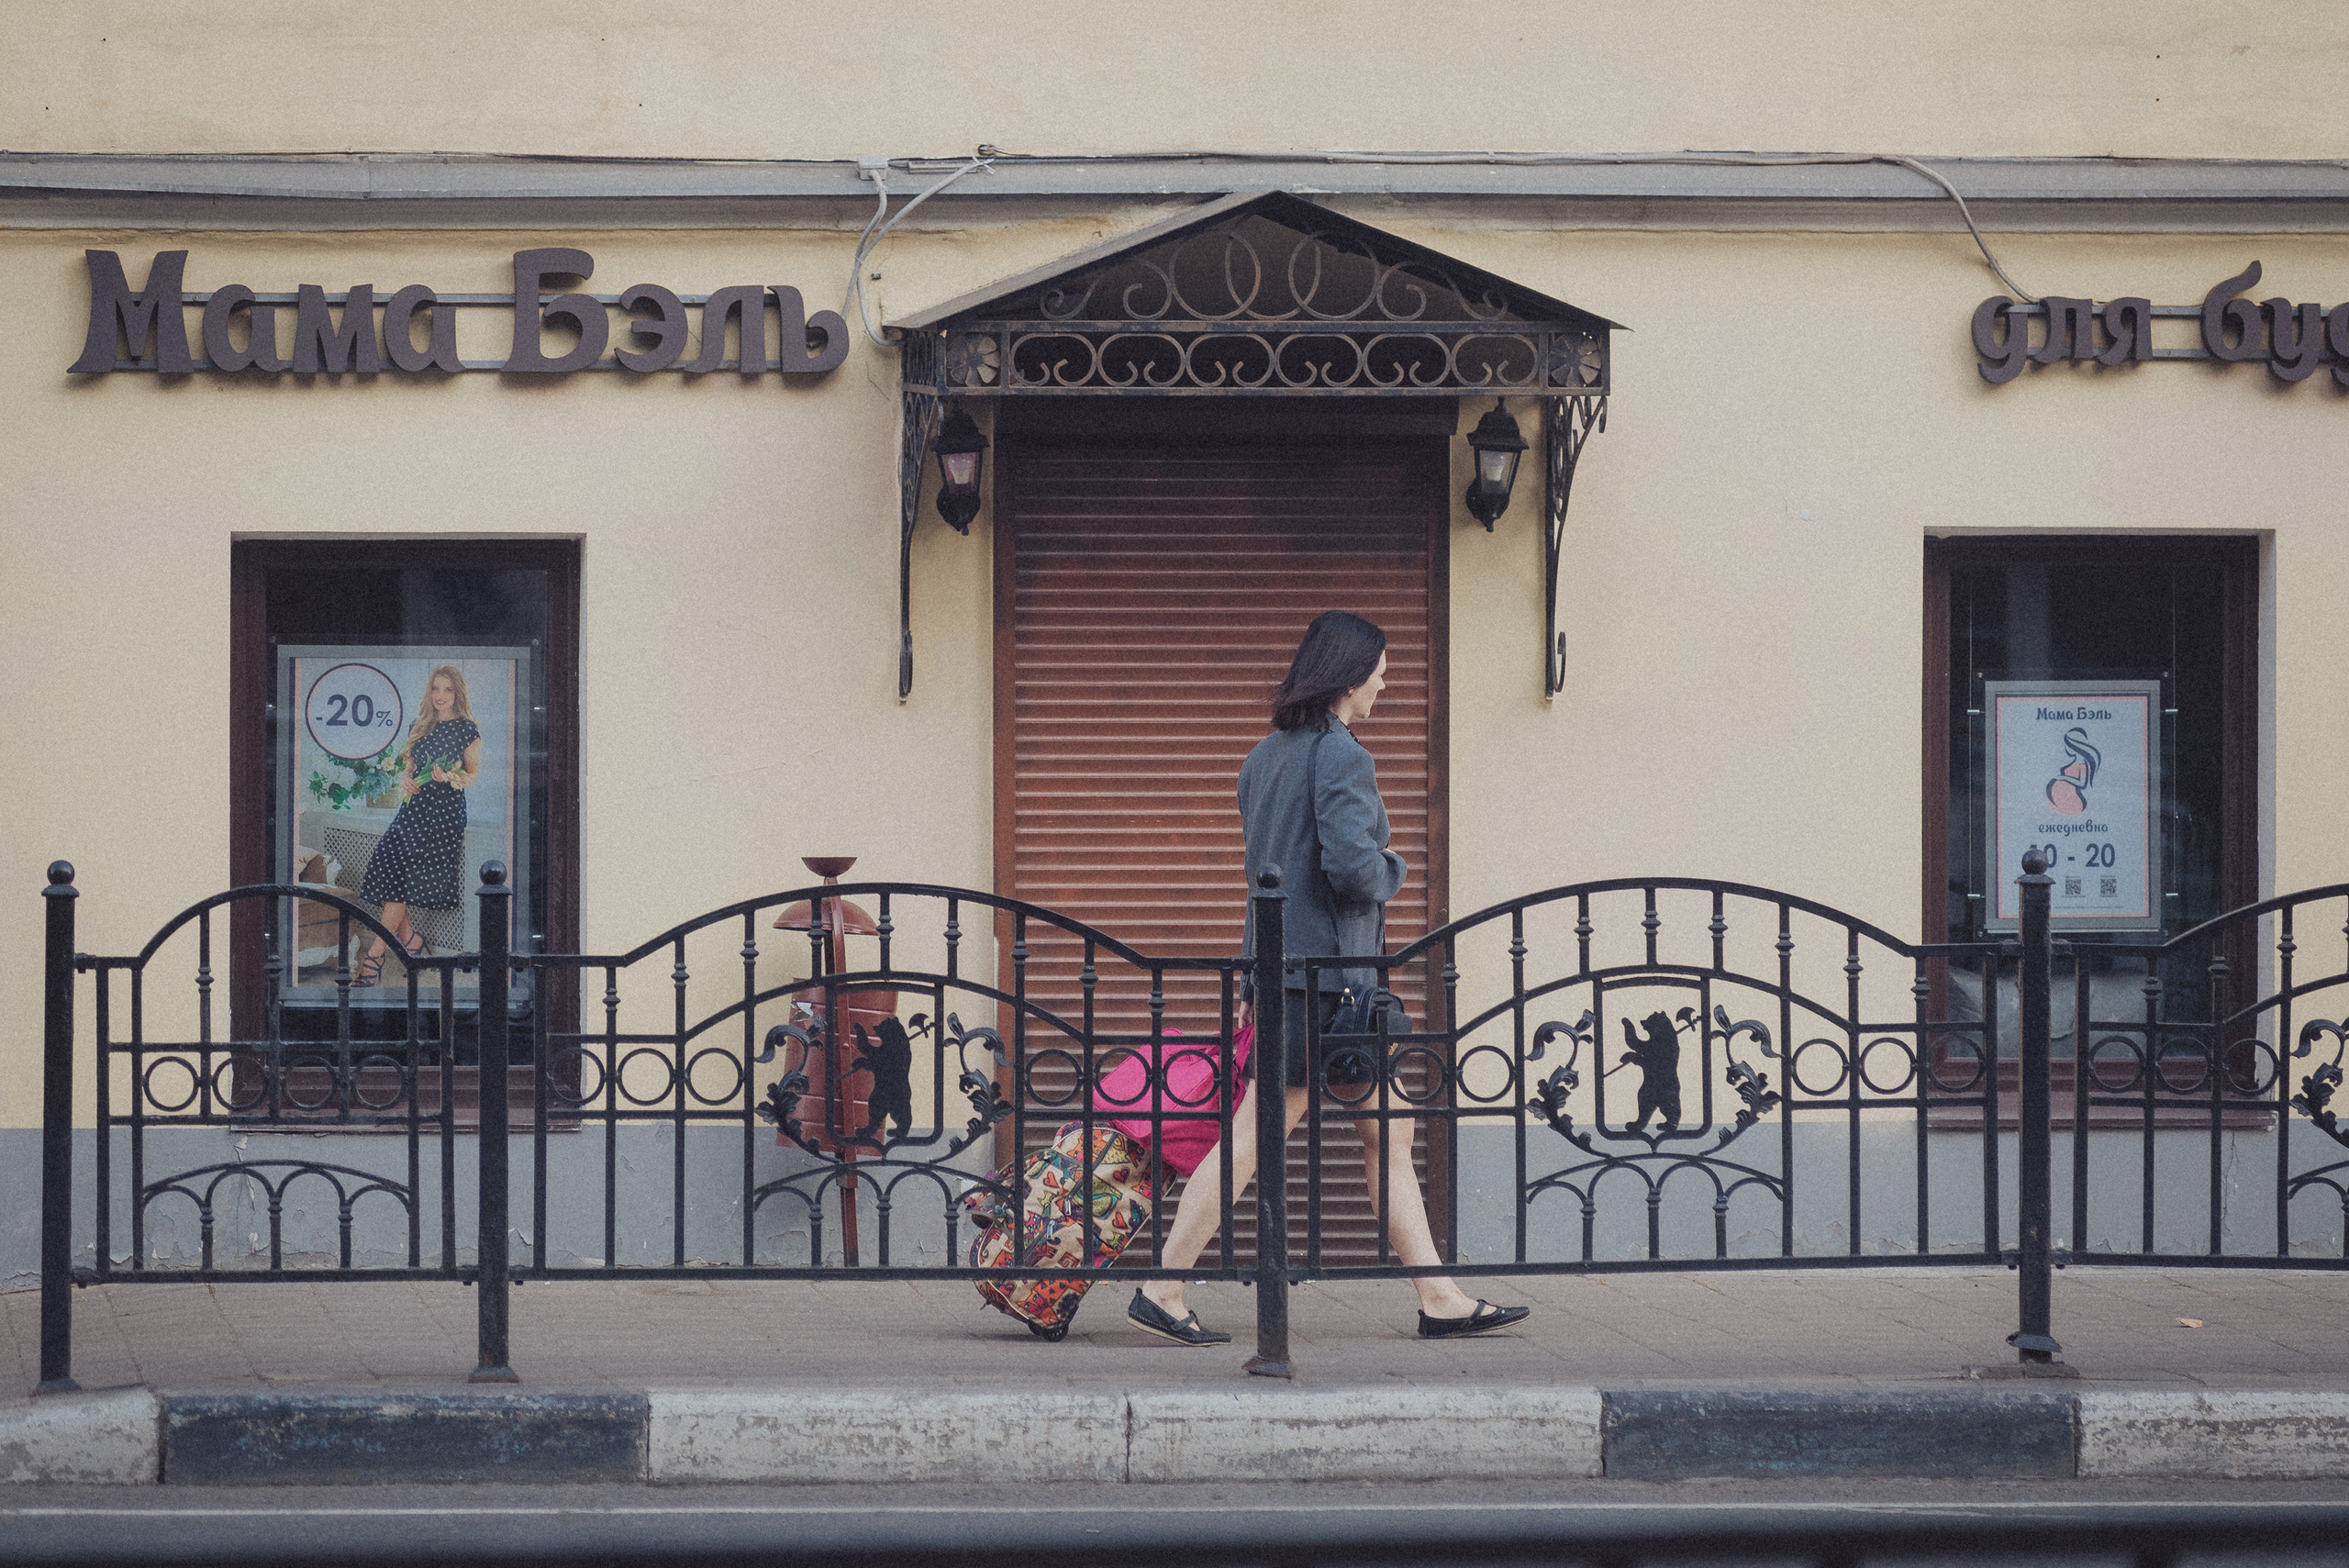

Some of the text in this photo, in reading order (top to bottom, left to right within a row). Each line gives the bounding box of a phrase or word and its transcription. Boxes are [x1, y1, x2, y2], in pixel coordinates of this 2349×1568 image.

[66, 247, 850, 373] Мама Бэль
[1971, 295, 2154, 384] для
[316, 694, 394, 728] -20%
[2036, 706, 2112, 721] Мама Бэль
[2038, 819, 2109, 837] ежедневно
[2029, 843, 2057, 868] 0
[2085, 843, 2116, 868] 20
